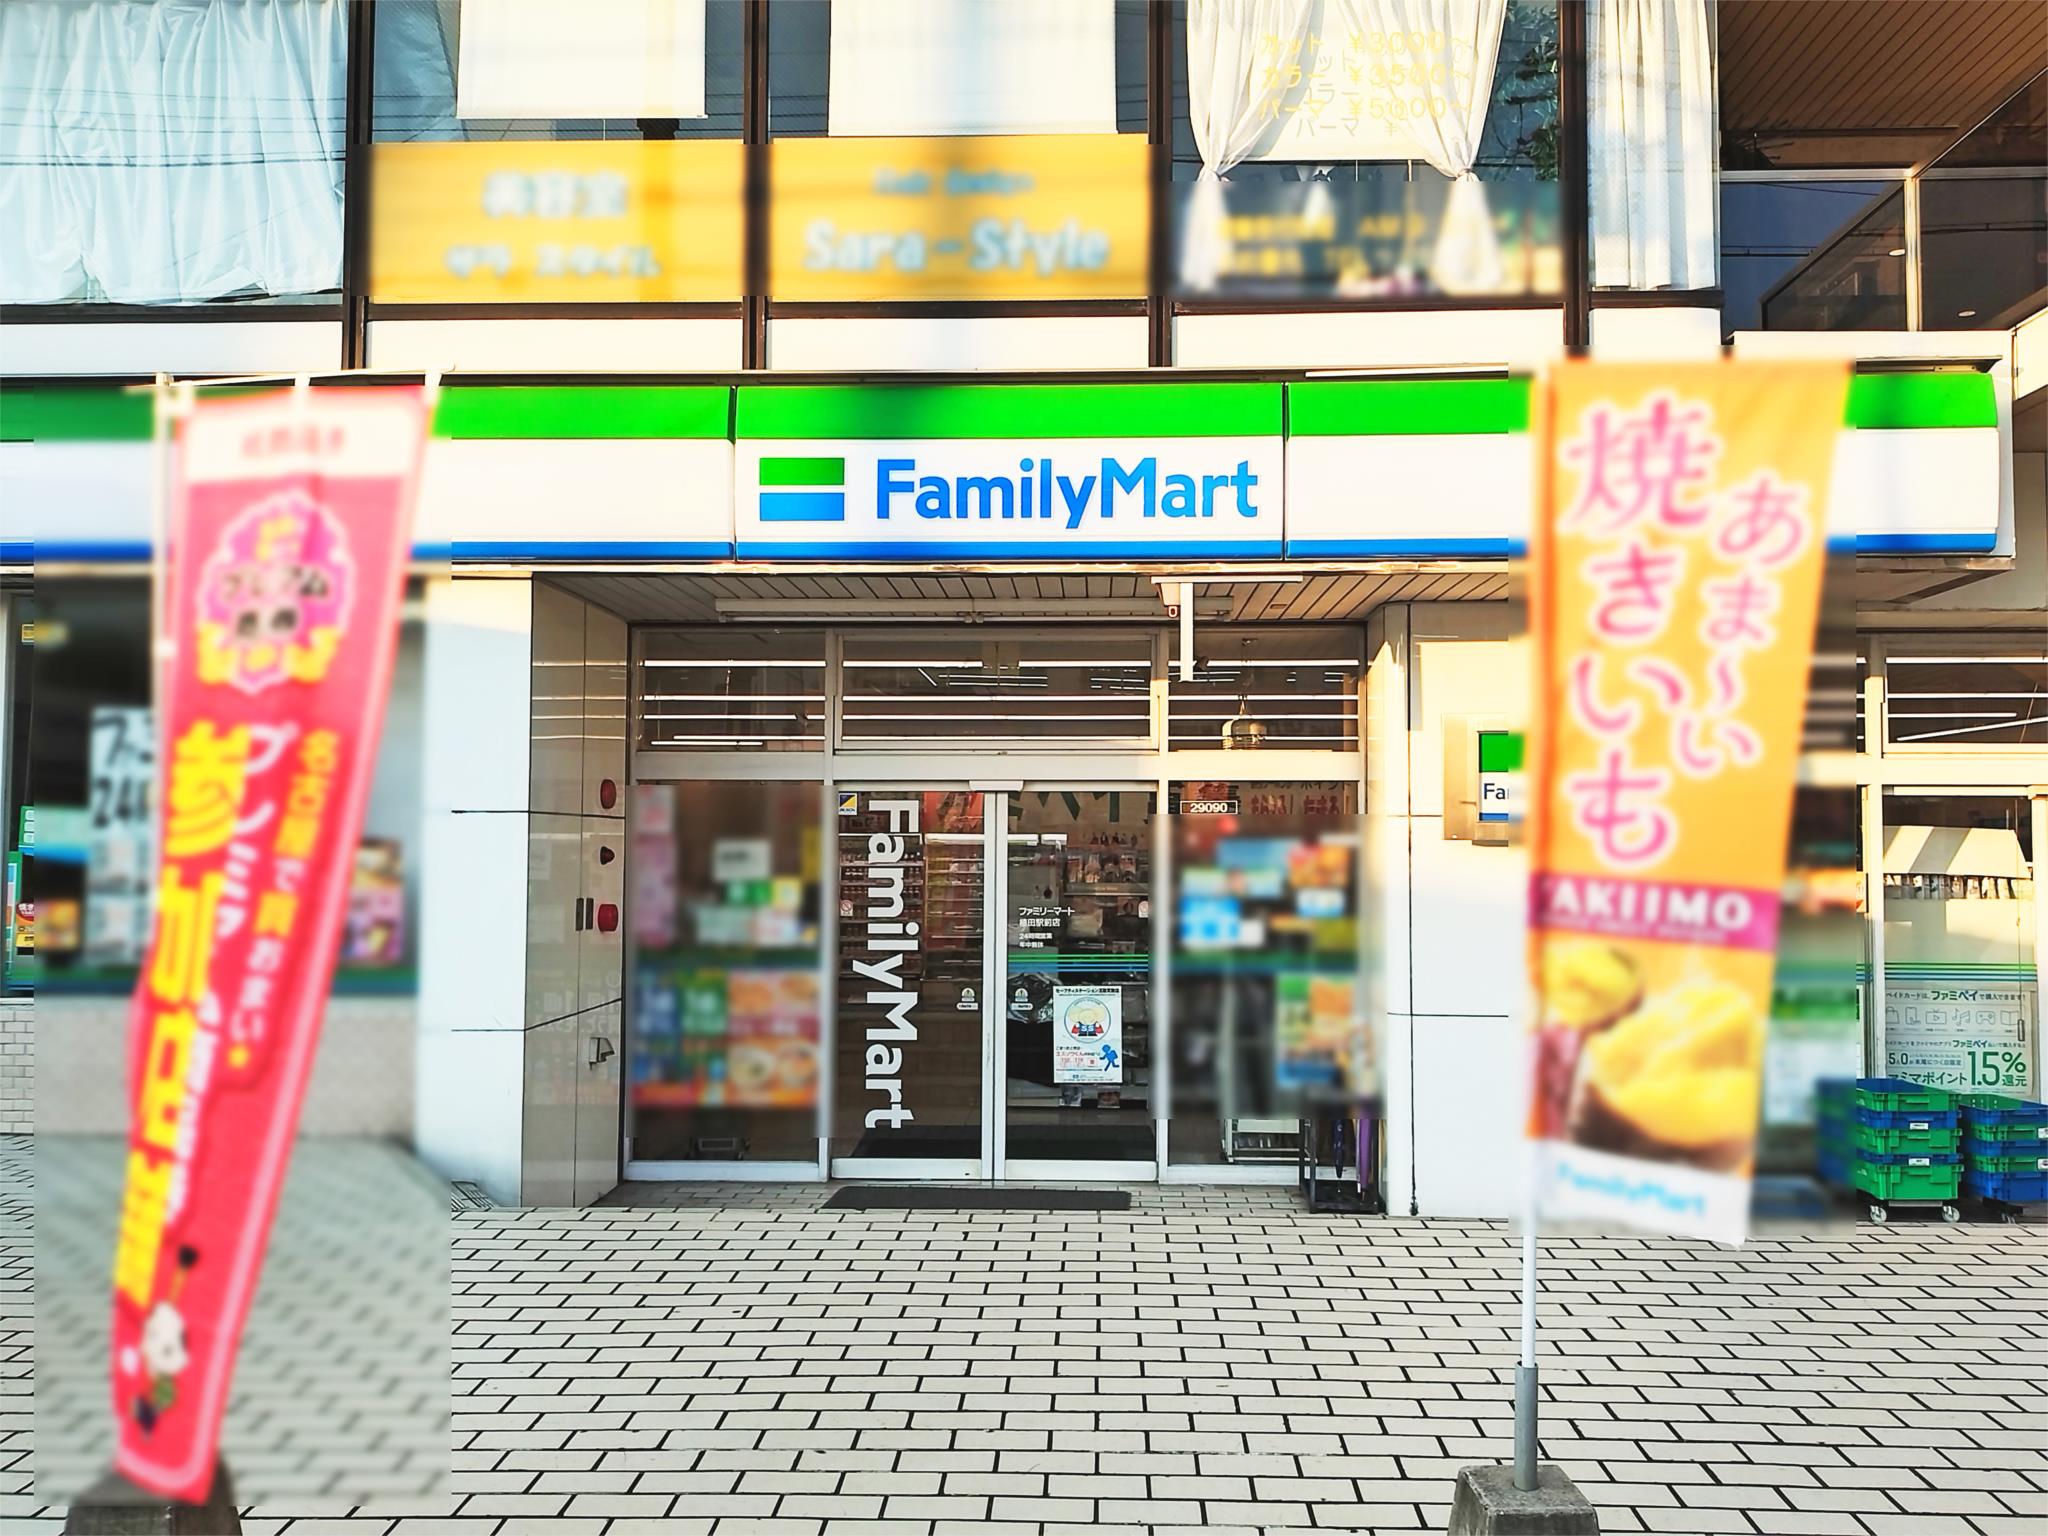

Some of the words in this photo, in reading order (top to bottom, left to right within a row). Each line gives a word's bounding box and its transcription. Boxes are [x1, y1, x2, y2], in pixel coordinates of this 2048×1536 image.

[876, 457, 1259, 529] FamilyMart
[1562, 396, 1716, 864] 焼きいも
[1190, 802, 1229, 813] 29090
[1018, 906, 1076, 917] ファミリーマート
[1545, 878, 1753, 931] AKIIMO
[852, 799, 920, 1129] FamilyMart
[1967, 1051, 2027, 1086] 1.5%
[2002, 1074, 2027, 1087] 還元
